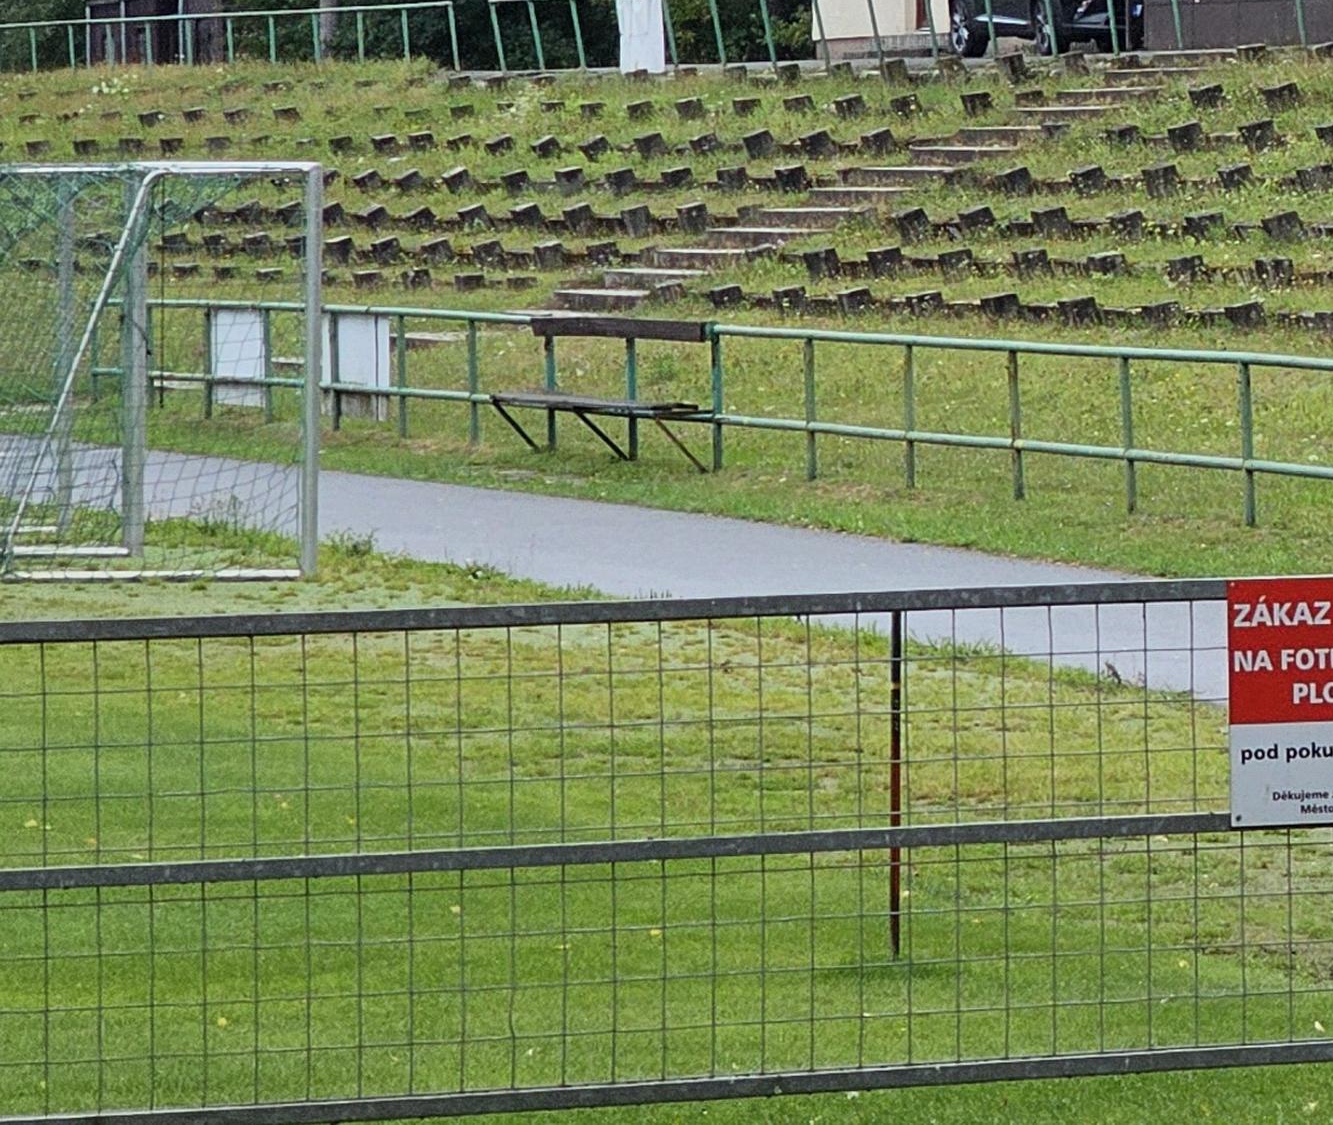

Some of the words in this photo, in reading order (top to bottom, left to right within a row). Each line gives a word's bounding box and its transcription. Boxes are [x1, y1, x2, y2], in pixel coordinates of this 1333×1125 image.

[1233, 595, 1331, 627] ZÁKAZ
[1234, 650, 1273, 672] NA
[1241, 744, 1279, 764] pod
[1272, 790, 1329, 802] Děkujeme
